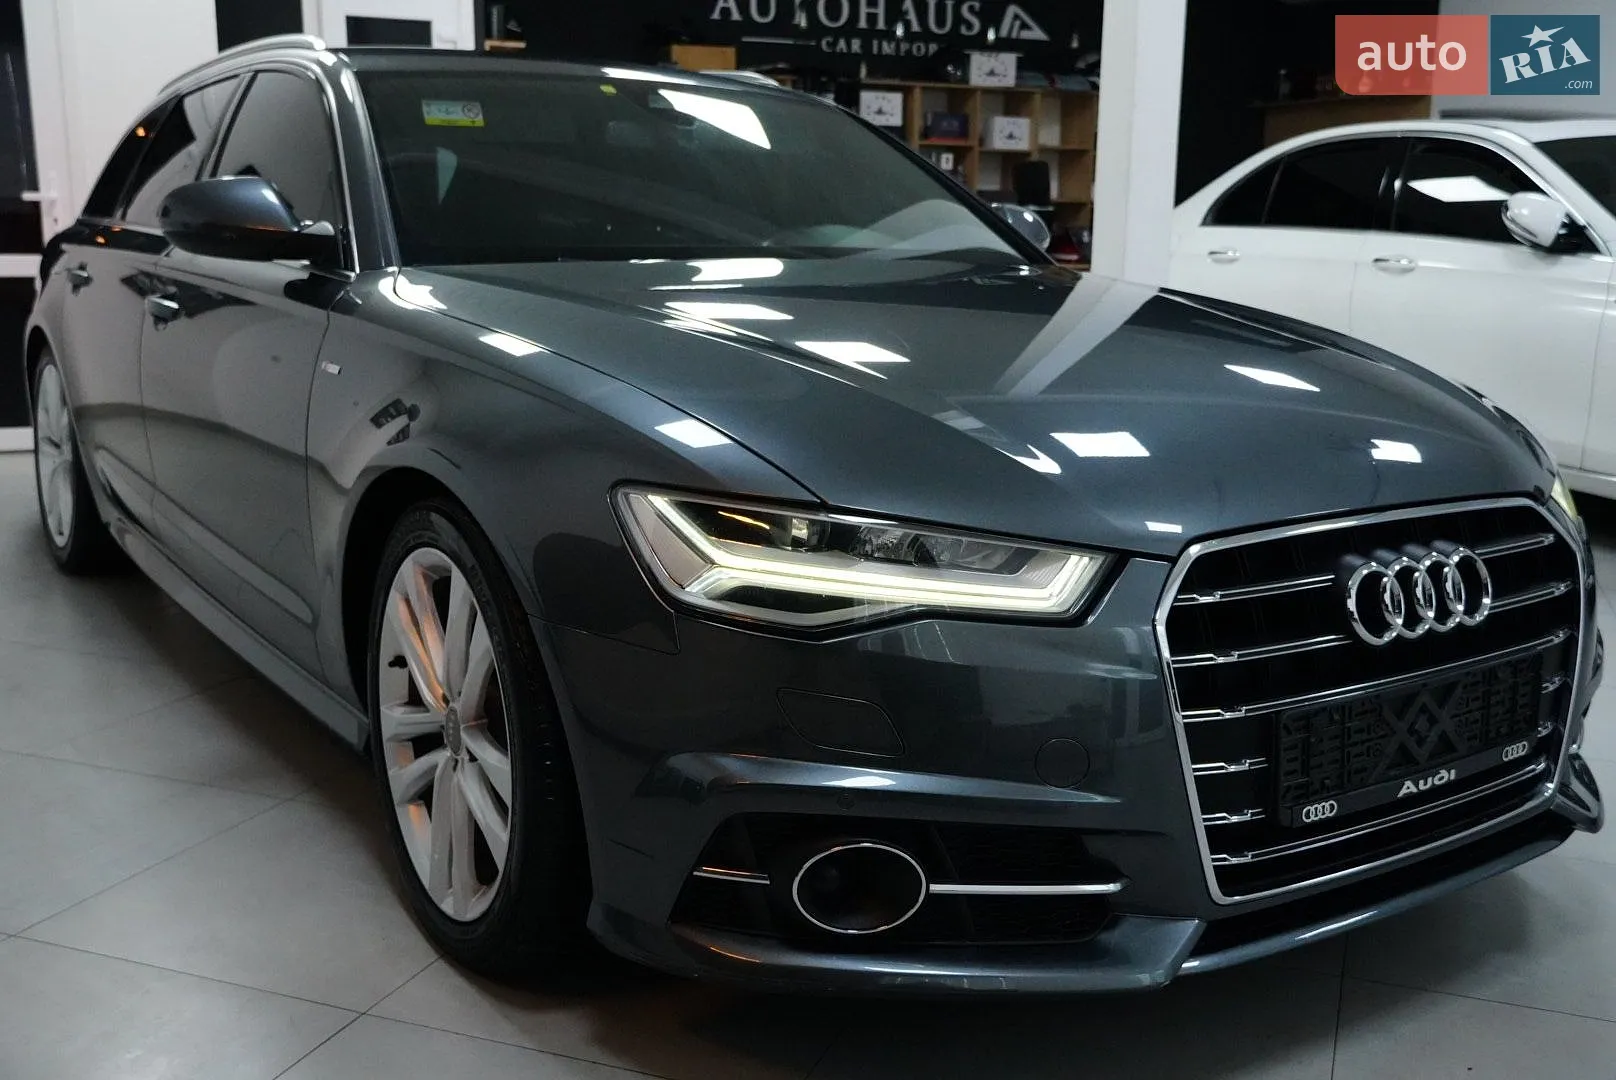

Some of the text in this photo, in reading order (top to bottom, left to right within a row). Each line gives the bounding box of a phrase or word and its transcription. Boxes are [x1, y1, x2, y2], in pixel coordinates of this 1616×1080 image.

[709, 0, 982, 37] AUTOHAUS
[820, 36, 862, 54] CAR
[1397, 768, 1456, 798] Audi
